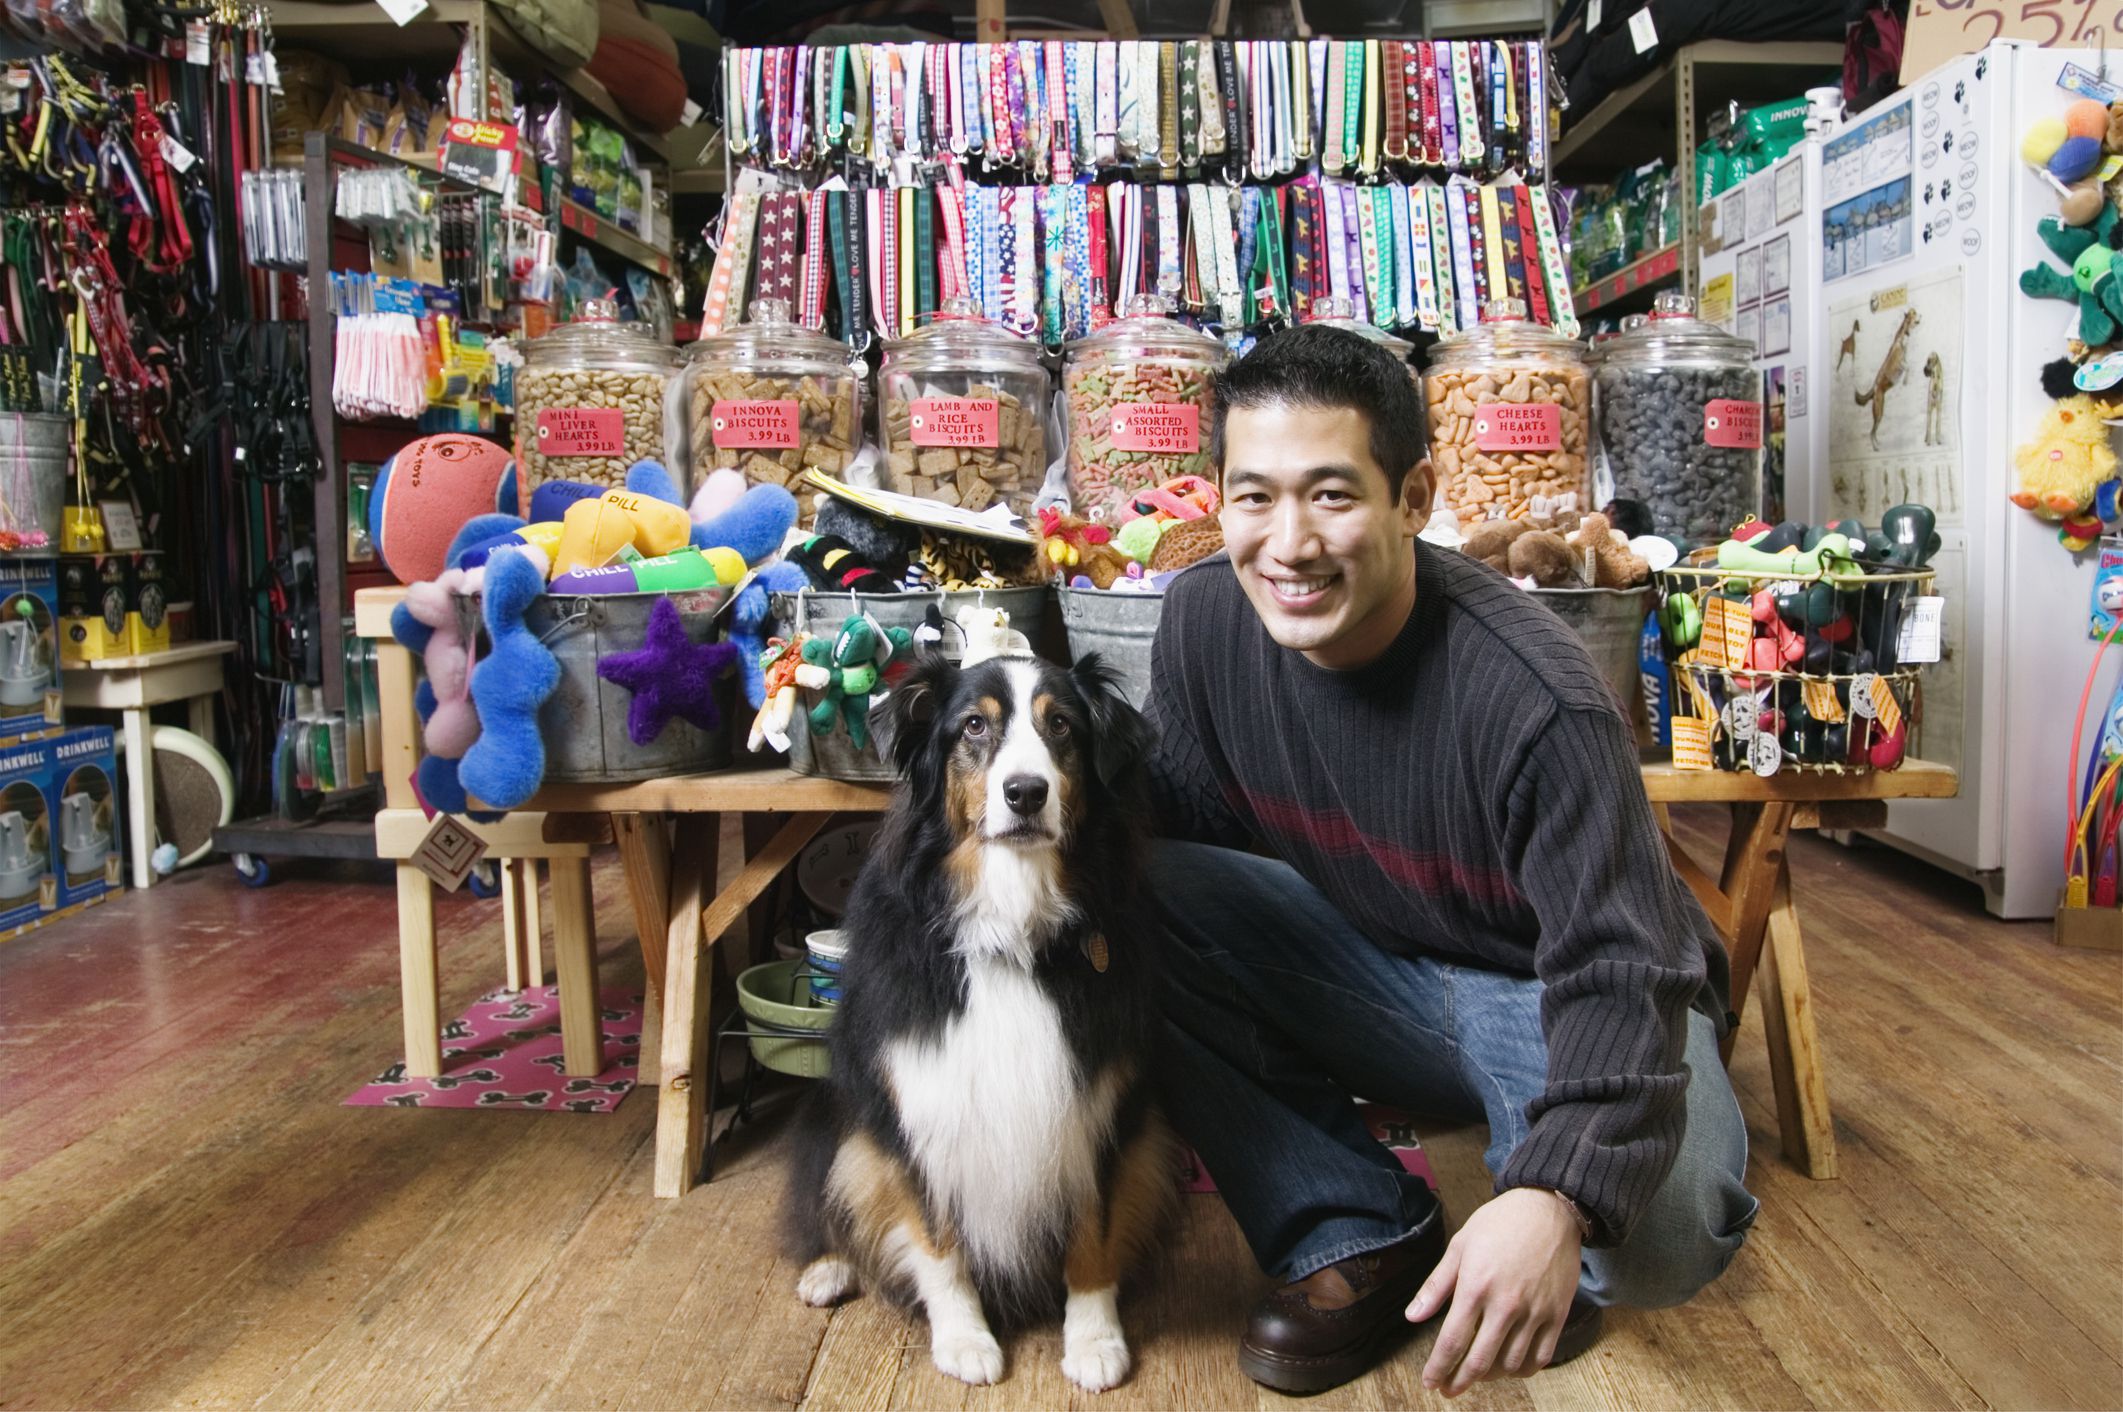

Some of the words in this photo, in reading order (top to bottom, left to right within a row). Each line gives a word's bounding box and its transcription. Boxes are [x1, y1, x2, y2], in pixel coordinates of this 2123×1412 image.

[1226, 77, 1235, 101] LOVE
[1770, 105, 1808, 123] INNOV
[1229, 112, 1239, 150] TENDER
[850, 228, 859, 242] ME
[850, 244, 860, 269] LOVE
[852, 278, 861, 312] TENDER
[733, 406, 782, 416] INNOVA
[930, 402, 961, 412] LAMB
[969, 402, 993, 412] AND
[1132, 405, 1169, 415] SMALL
[550, 410, 579, 421] MINI
[938, 414, 968, 424] RICE
[1496, 408, 1543, 419] CHEESE
[560, 419, 597, 431] LIVER
[728, 418, 787, 428] BISCUITS
[1125, 416, 1182, 426] ASSORTED
[1499, 421, 1547, 432] HEARTS
[929, 423, 984, 434] BISCUITS
[1135, 426, 1189, 437] BISCUITS
[555, 431, 599, 441] HEARTS
[748, 430, 773, 441] 3.99
[776, 432, 791, 443] LB
[948, 435, 969, 445] 3.99
[972, 434, 985, 445] LB
[1510, 435, 1533, 445] 3.99
[1536, 435, 1550, 445] LB
[601, 441, 615, 451] LB
[1147, 437, 1171, 448] 3.99
[1175, 439, 1189, 449] LB
[550, 482, 595, 499] CHILL
[607, 494, 640, 513] PILL
[636, 556, 678, 570] PILL
[570, 564, 629, 580] CHILL
[1705, 621, 1747, 637] DURBLE
[1727, 639, 1745, 649] TOY
[56, 735, 110, 759] DRINKWELL
